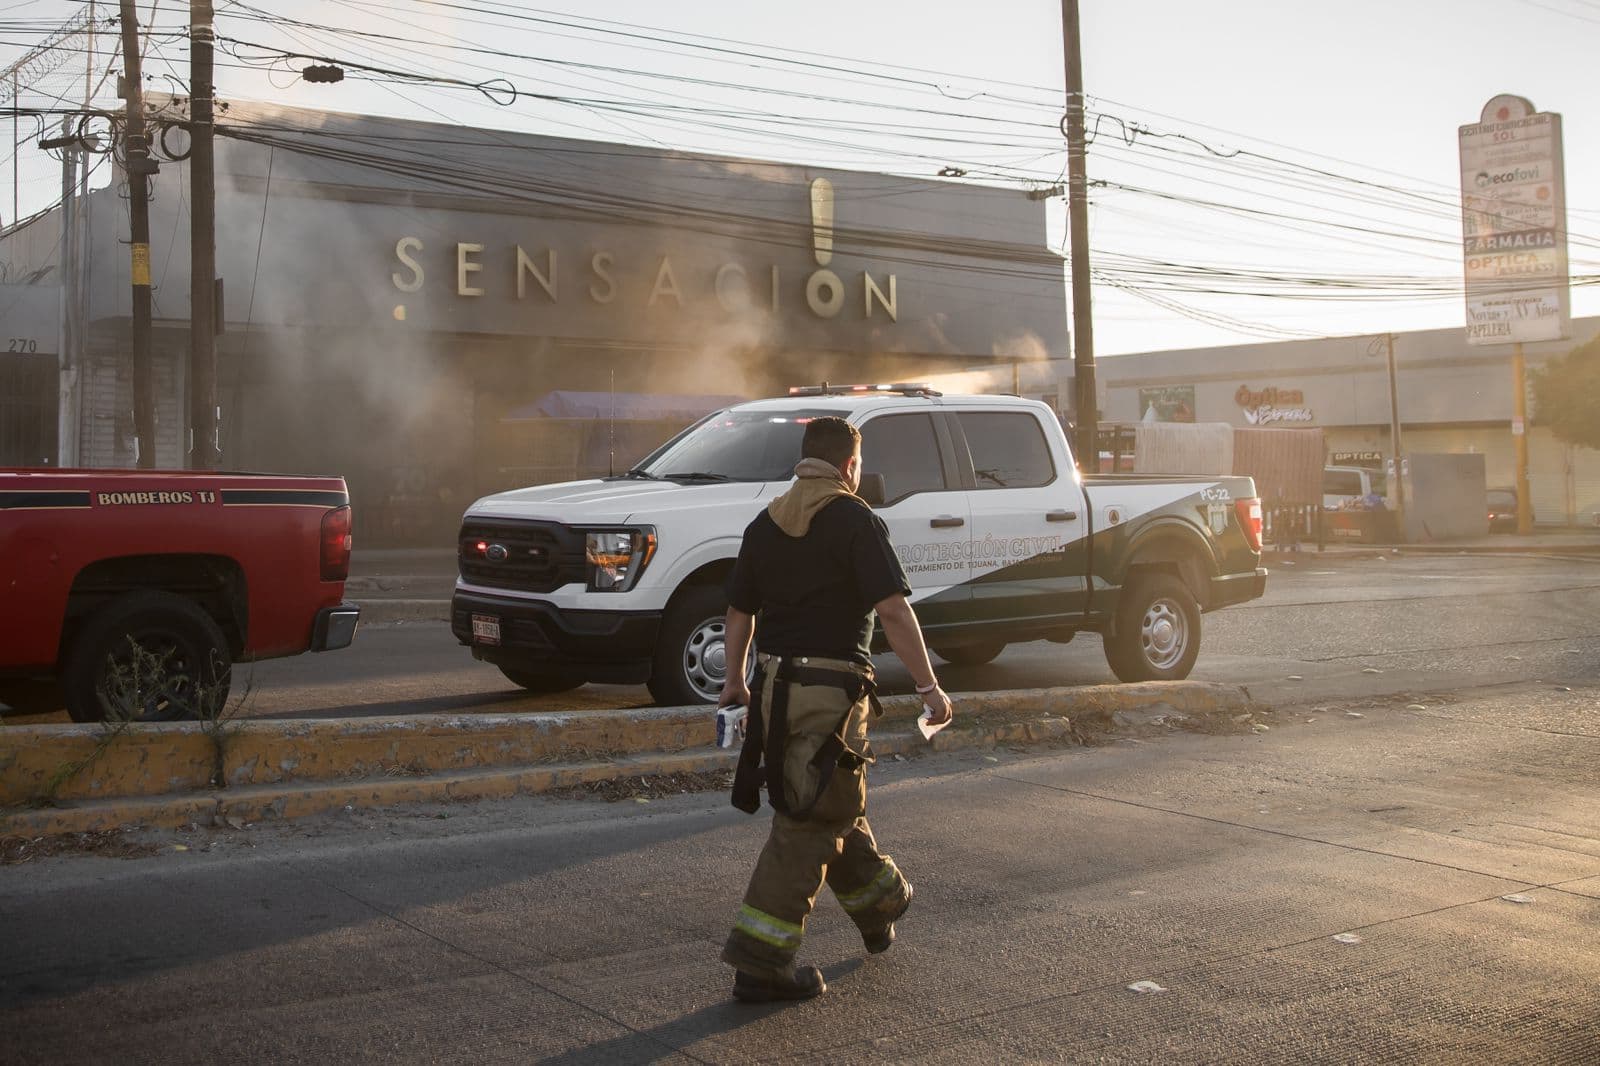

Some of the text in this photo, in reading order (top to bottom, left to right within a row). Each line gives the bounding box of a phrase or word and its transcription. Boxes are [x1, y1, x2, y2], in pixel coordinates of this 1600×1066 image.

[1465, 230, 1554, 252] FARMACIA
[9, 338, 37, 353] 270
[1335, 452, 1382, 461] OPTICA
[98, 491, 217, 506] BOMBEROS TJ
[1200, 488, 1230, 501] PC-22
[896, 533, 1008, 563] ROTECCIÓN
[1009, 535, 1066, 557] CIVIL
[953, 562, 965, 570] DE
